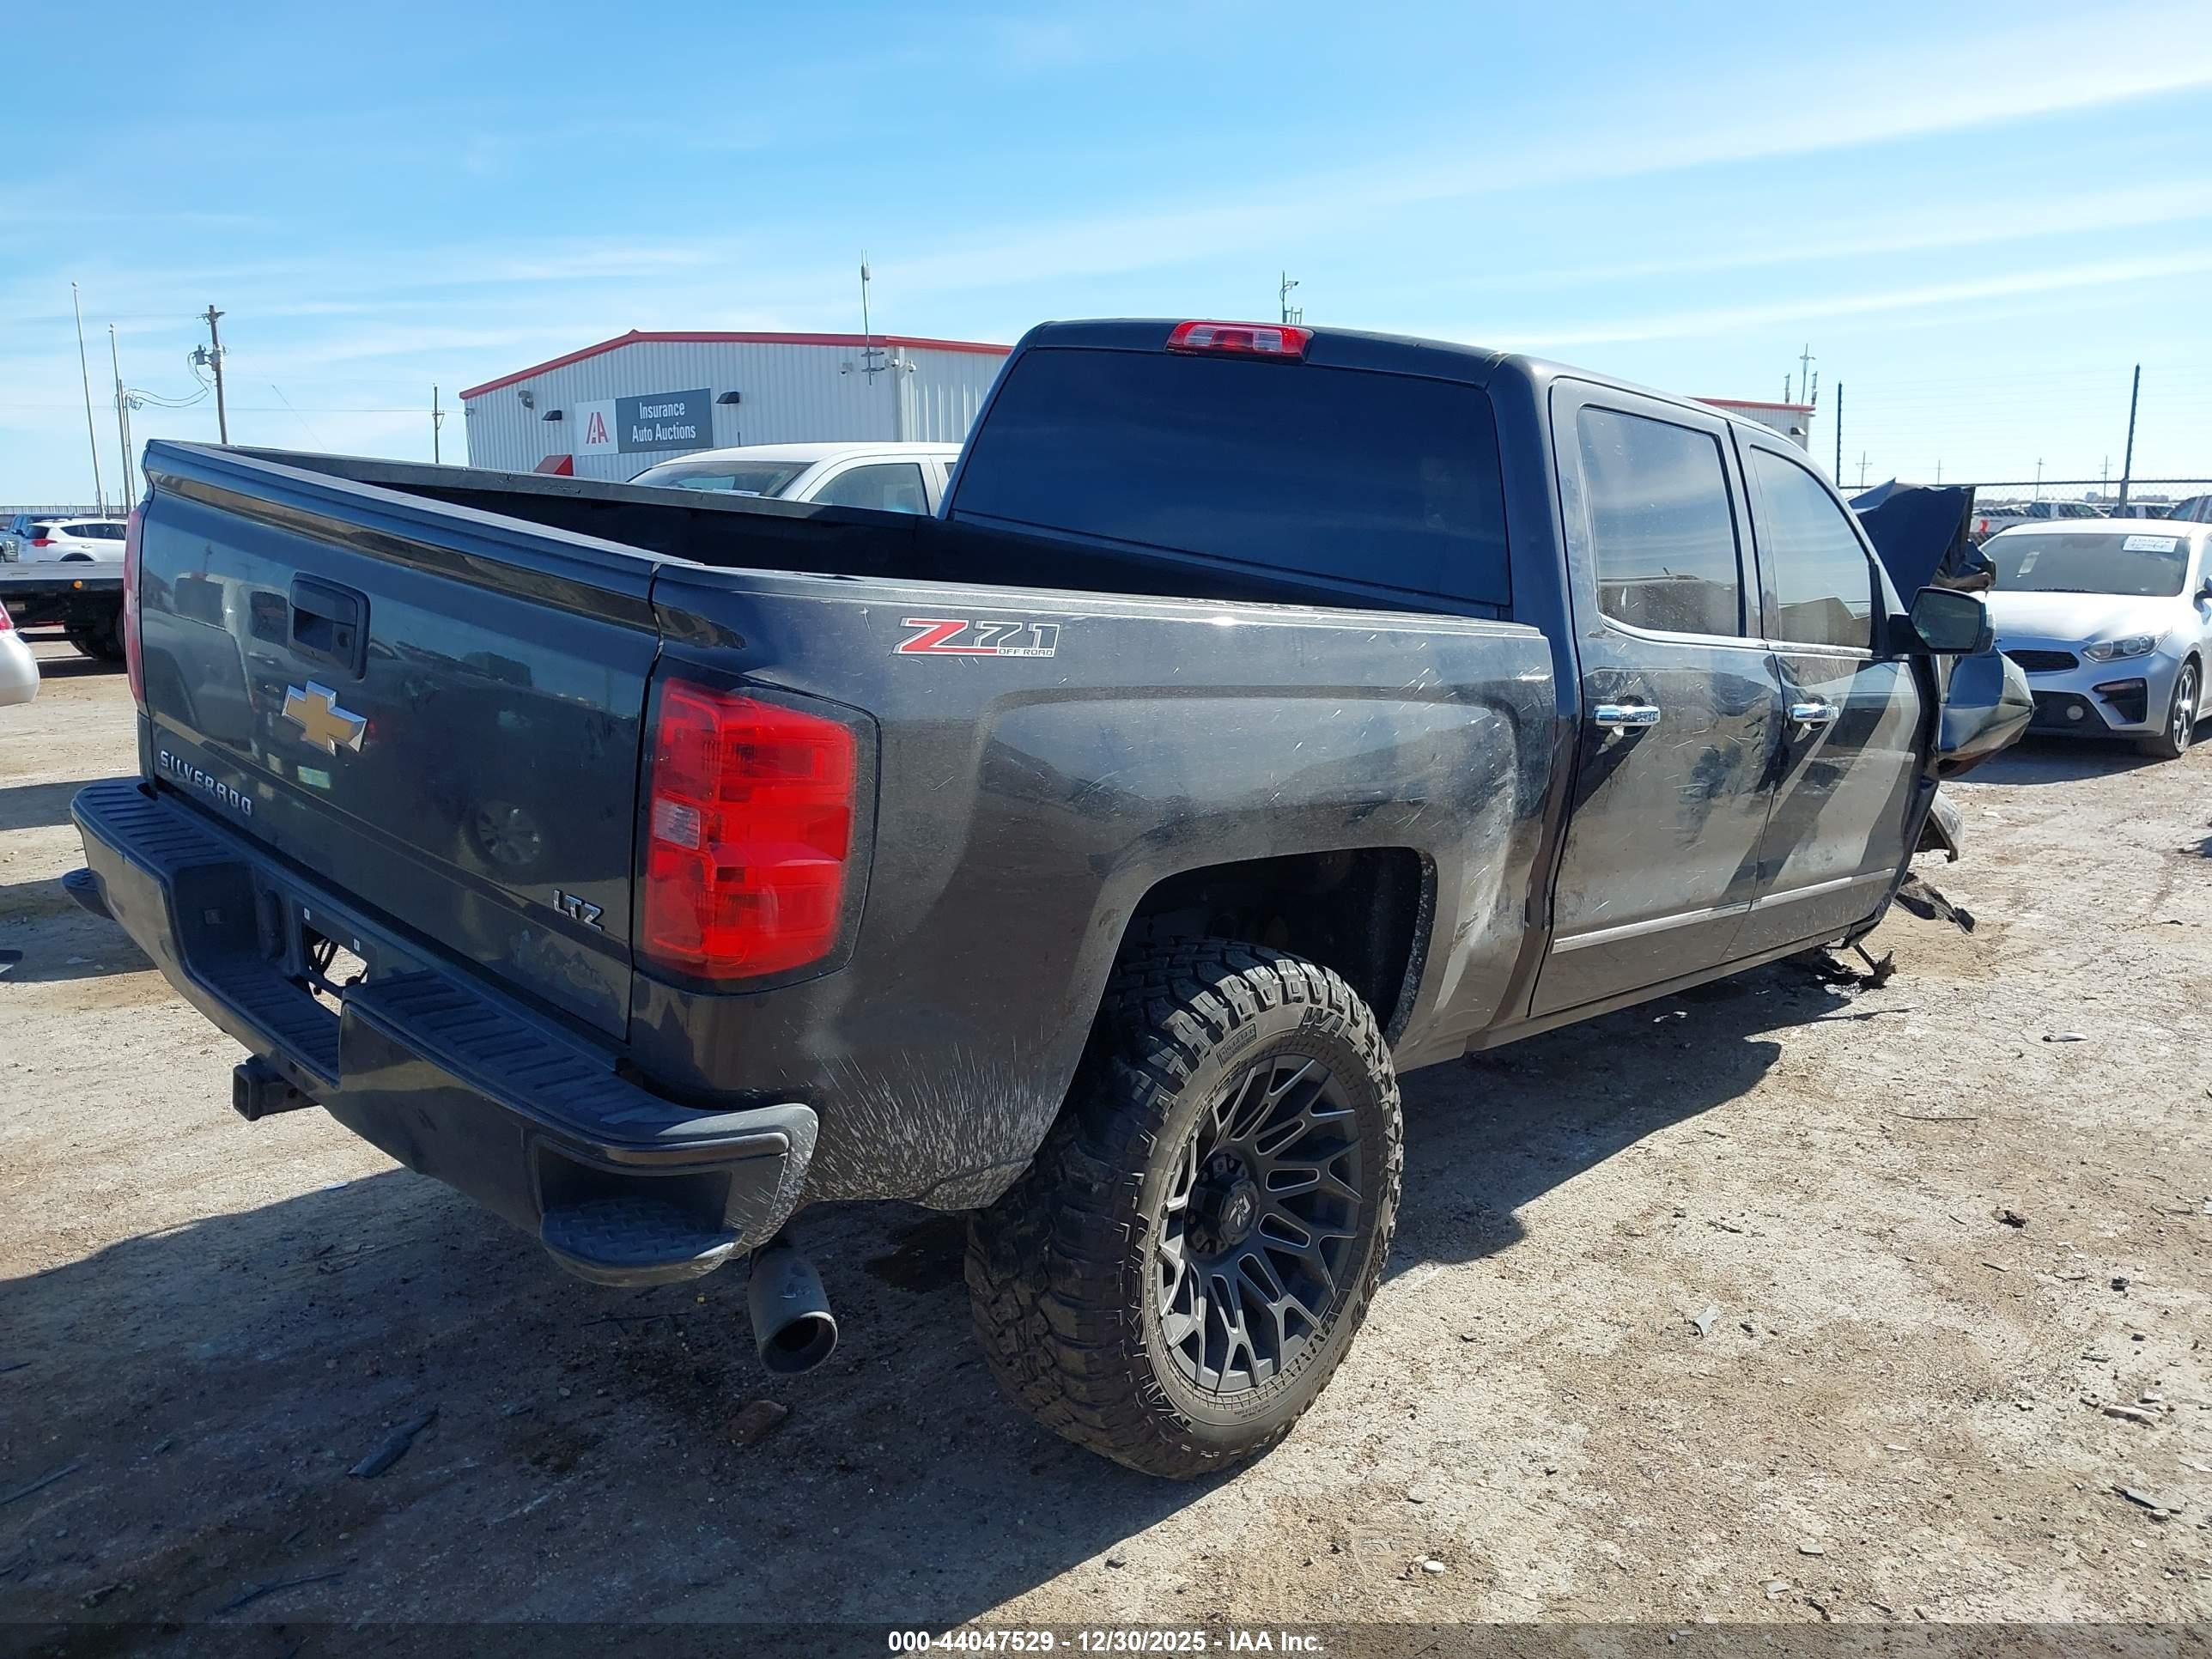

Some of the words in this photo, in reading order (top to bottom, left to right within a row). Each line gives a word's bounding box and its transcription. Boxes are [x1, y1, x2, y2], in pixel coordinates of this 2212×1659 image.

[639, 401, 686, 420] Insurance
[631, 425, 653, 443] Auto
[654, 421, 696, 441] Auctions
[892, 617, 1062, 656] Z71
[160, 750, 252, 817] SILVERADO
[552, 889, 604, 933] LTZ
